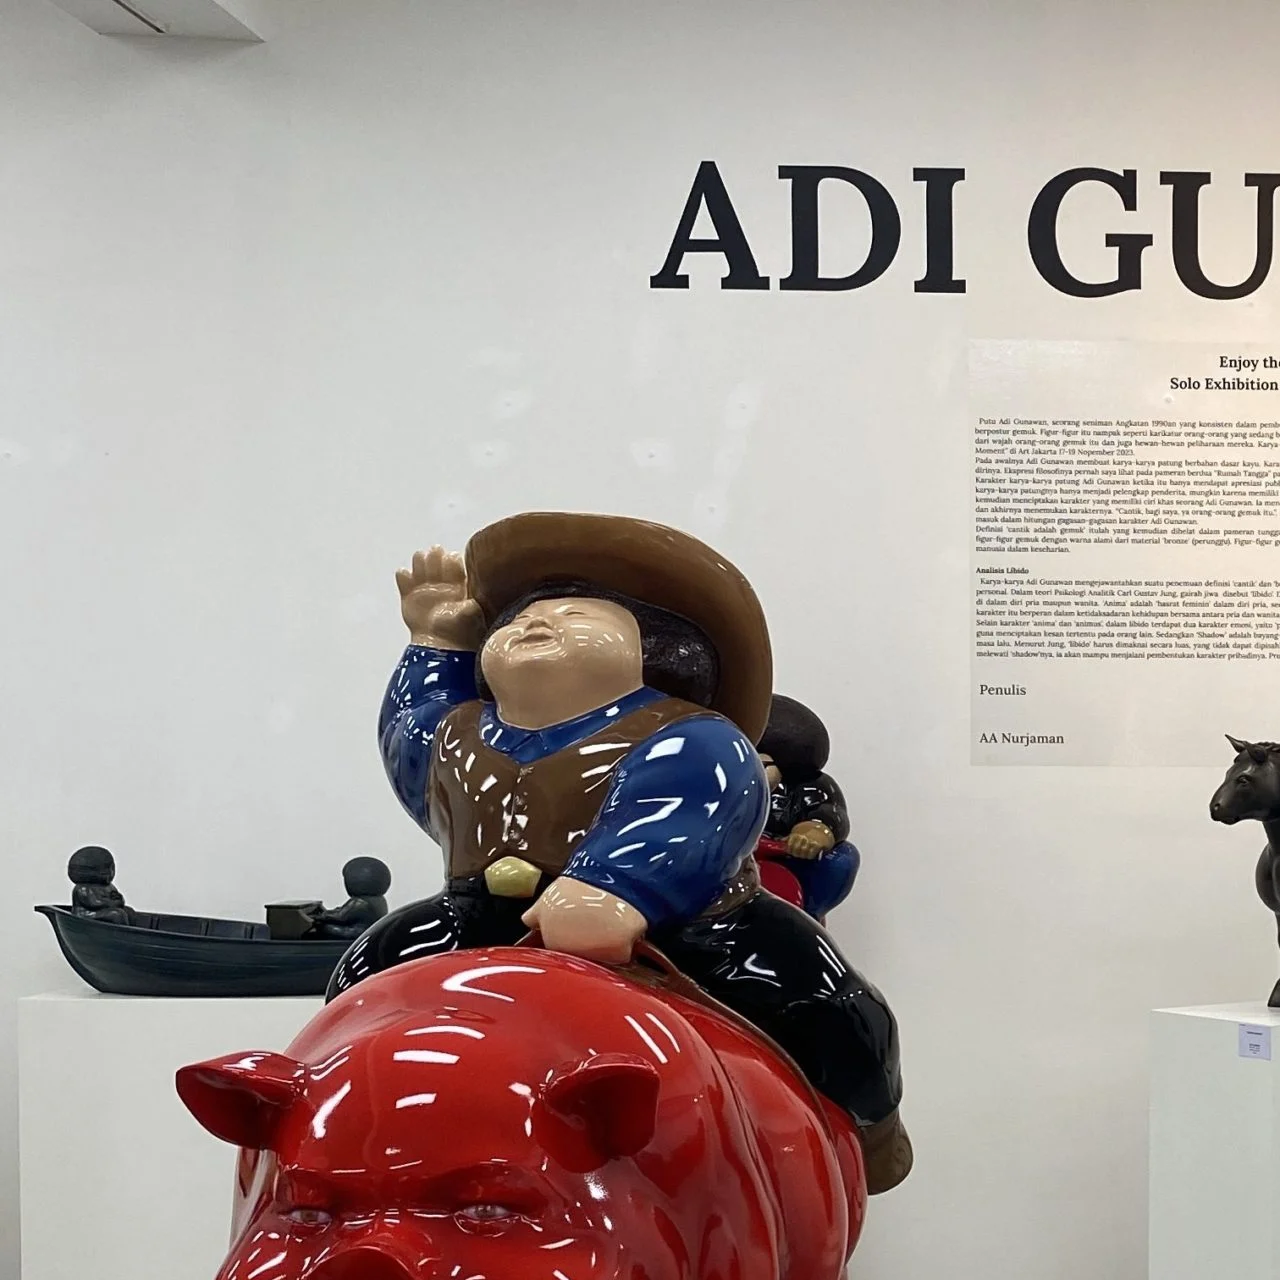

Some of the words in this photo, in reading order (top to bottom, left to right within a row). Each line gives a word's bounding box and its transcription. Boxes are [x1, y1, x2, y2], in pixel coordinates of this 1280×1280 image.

[649, 160, 967, 294] ADI
[1219, 355, 1259, 373] Enjoy
[1170, 377, 1201, 392] Solo
[1205, 377, 1279, 393] Exhibition
[978, 417, 997, 425] Putu
[1013, 418, 1048, 426] Gunawan,
[1051, 420, 1081, 428] seorang
[1082, 418, 1113, 426] seniman
[1115, 419, 1149, 429] Angkatan
[1179, 422, 1197, 430] yang
[1198, 420, 1234, 428] konsisten
[1235, 420, 1258, 428] dalam
[1184, 431, 1229, 440] orang-orang
[1230, 432, 1248, 440] yang
[1248, 430, 1274, 440] sedang
[1187, 439, 1225, 449] peliharaan
[1226, 440, 1254, 448] mereka.
[975, 446, 1008, 454] Moment"
[1031, 447, 1058, 455] Jakarta
[1077, 448, 1115, 458] Nopember
[975, 456, 993, 464] Pada
[994, 456, 1024, 467] awalnya
[1039, 457, 1074, 465] Gunawan
[1076, 458, 1110, 466] membuat
[1112, 458, 1156, 468] karya-karya
[1157, 459, 1183, 468] patung
[1073, 467, 1100, 477] pernah
[1101, 470, 1117, 478] saya
[1118, 468, 1134, 476] lihat
[1135, 468, 1154, 478] pada
[1132, 478, 1155, 486] ketika
[1169, 478, 1191, 488] hanya
[1193, 478, 1228, 489] mendapat
[1059, 487, 1082, 497] hanya
[1082, 487, 1112, 497] menjadi
[1112, 487, 1150, 498] pelengkap
[1059, 496, 1090, 504] karakter
[1092, 499, 1110, 507] yang
[1110, 497, 1142, 505] memiliki
[1143, 497, 1156, 505] ciri
[1163, 517, 1198, 525] Gunawan.
[1198, 527, 1221, 535] dalam
[1223, 529, 1255, 537] pameran
[1014, 535, 1040, 545] gemuk
[1041, 535, 1068, 545] dengan
[1093, 536, 1113, 544] alami
[1114, 536, 1130, 544] dari
[1131, 536, 1161, 544] material
[975, 544, 1006, 552] manusia
[1030, 545, 1070, 553] keseharian.
[976, 566, 1005, 574] Analisis
[1006, 566, 1030, 574] Libido
[980, 577, 1025, 587] Karya-karya
[1039, 578, 1074, 586] Gunawan
[1010, 588, 1034, 596] Dalam
[1034, 588, 1053, 596] teori
[1054, 588, 1087, 598] Psikologi
[1133, 589, 1158, 597] Gustav
[1160, 589, 1178, 599] Jung,
[1169, 610, 1201, 618] bersama
[1201, 610, 1225, 618] antara
[1225, 610, 1241, 620] pria
[1256, 610, 1280, 618] wanita
[976, 618, 998, 626] Selain
[1097, 630, 1115, 640] pada
[1116, 632, 1138, 640] orang
[1138, 630, 1154, 638] lain.
[1193, 643, 1211, 651] yang
[1212, 641, 1230, 649] tidak
[1232, 641, 1252, 651] dapat
[979, 683, 1028, 697] Penulis
[979, 732, 998, 745] AA
[1001, 732, 1065, 749] Nurjaman
